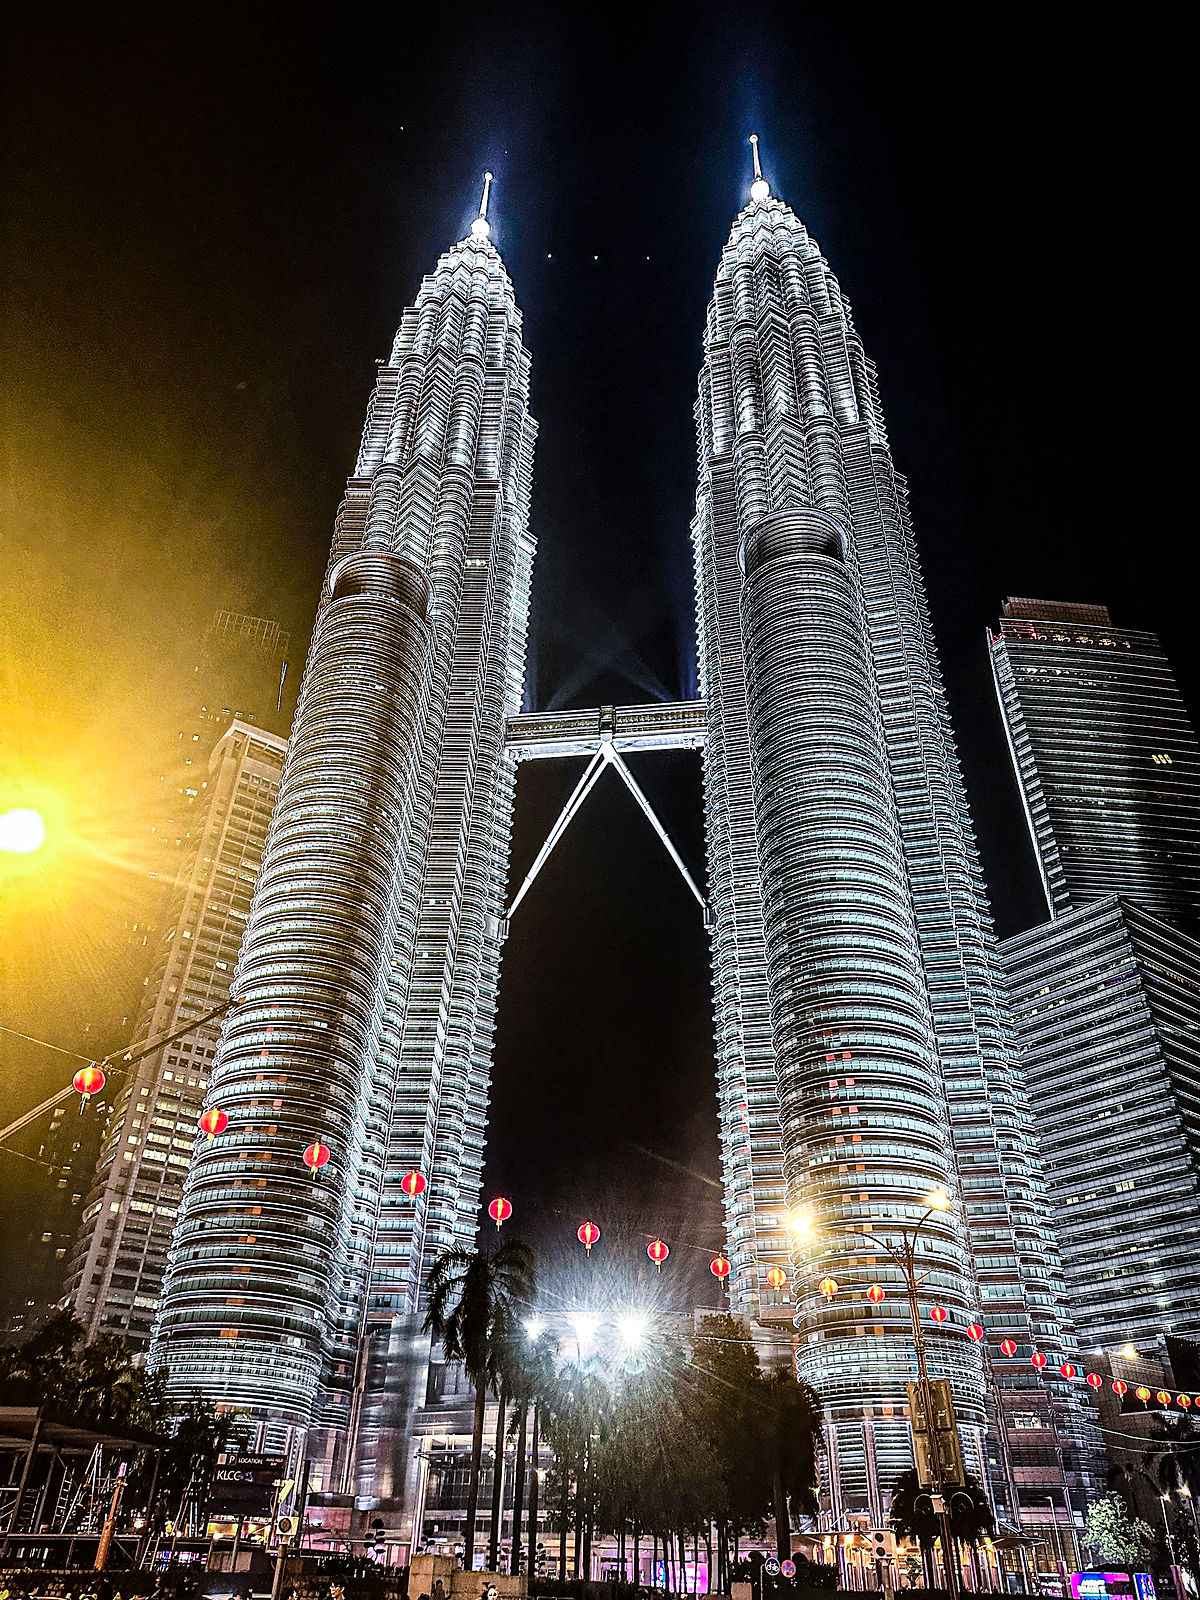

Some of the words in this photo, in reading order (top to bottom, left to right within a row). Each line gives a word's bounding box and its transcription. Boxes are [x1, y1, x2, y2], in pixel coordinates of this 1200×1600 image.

[228, 1455, 236, 1464] P
[238, 1457, 263, 1465] LOCATION
[216, 1469, 241, 1481] KLCC
